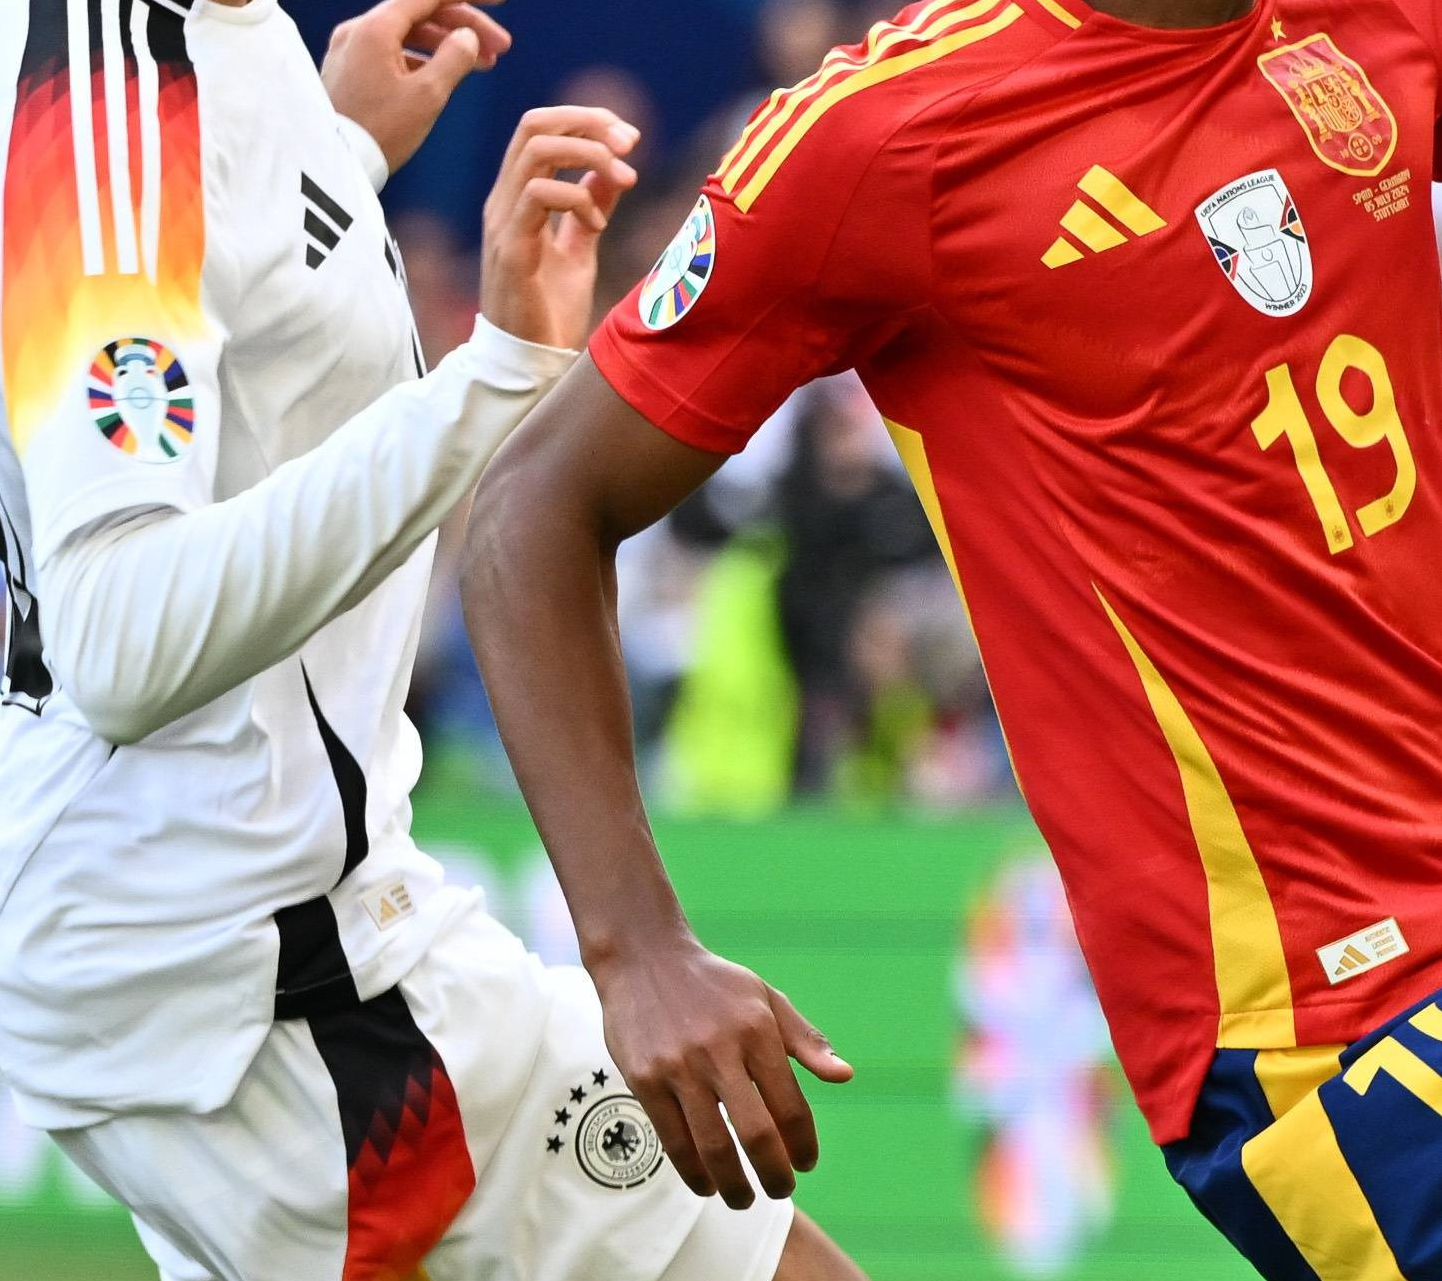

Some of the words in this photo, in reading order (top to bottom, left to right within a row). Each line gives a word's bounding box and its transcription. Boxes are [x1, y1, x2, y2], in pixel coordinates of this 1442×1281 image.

[1200, 203, 1217, 218] UEFA
[1216, 182, 1247, 204] NATIONS
[1247, 174, 1275, 189] LEAGUE
[1264, 298, 1295, 311] WINNER
[1250, 333, 1417, 556] 19
